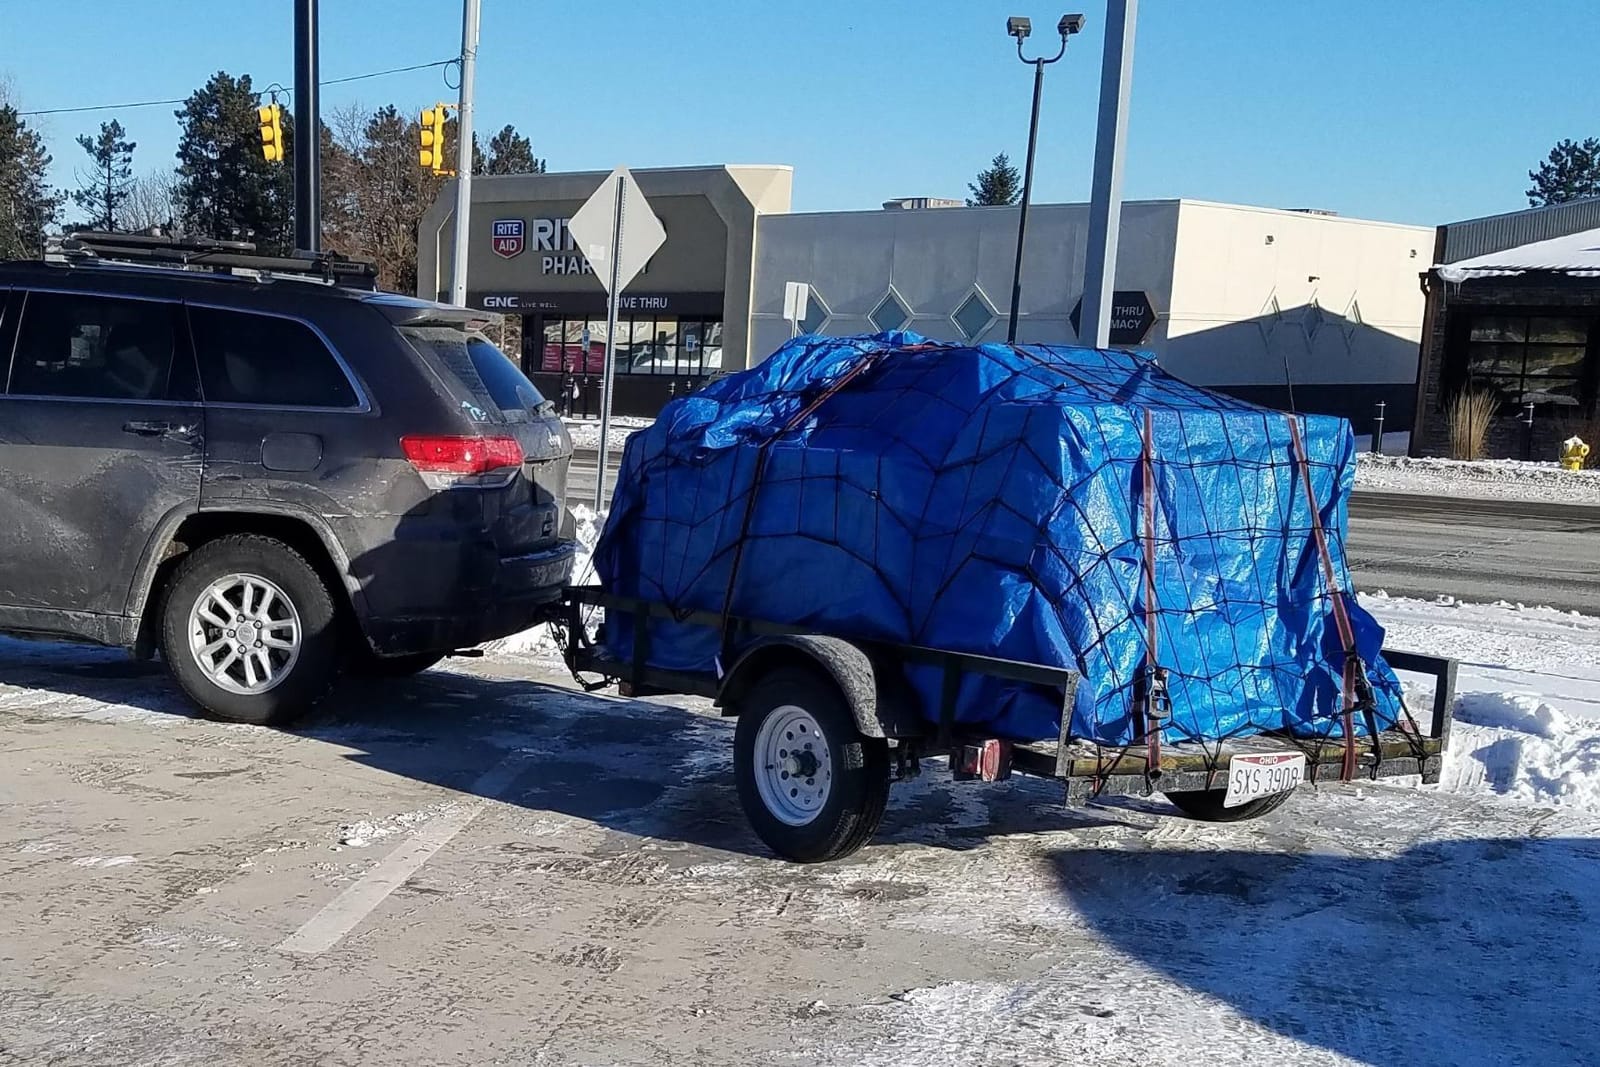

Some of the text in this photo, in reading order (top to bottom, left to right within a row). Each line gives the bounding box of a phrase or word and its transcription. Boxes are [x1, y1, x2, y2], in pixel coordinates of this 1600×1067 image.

[497, 223, 519, 235] RITE
[532, 218, 577, 251] RIT
[498, 239, 518, 251] AID
[542, 256, 593, 274] PHAR
[483, 296, 520, 308] GNC
[639, 297, 668, 308] THRU
[1114, 306, 1144, 316] THRU
[1110, 319, 1141, 329] MACY
[1259, 756, 1278, 765] OHIO
[1233, 767, 1299, 794] SXS 3908
